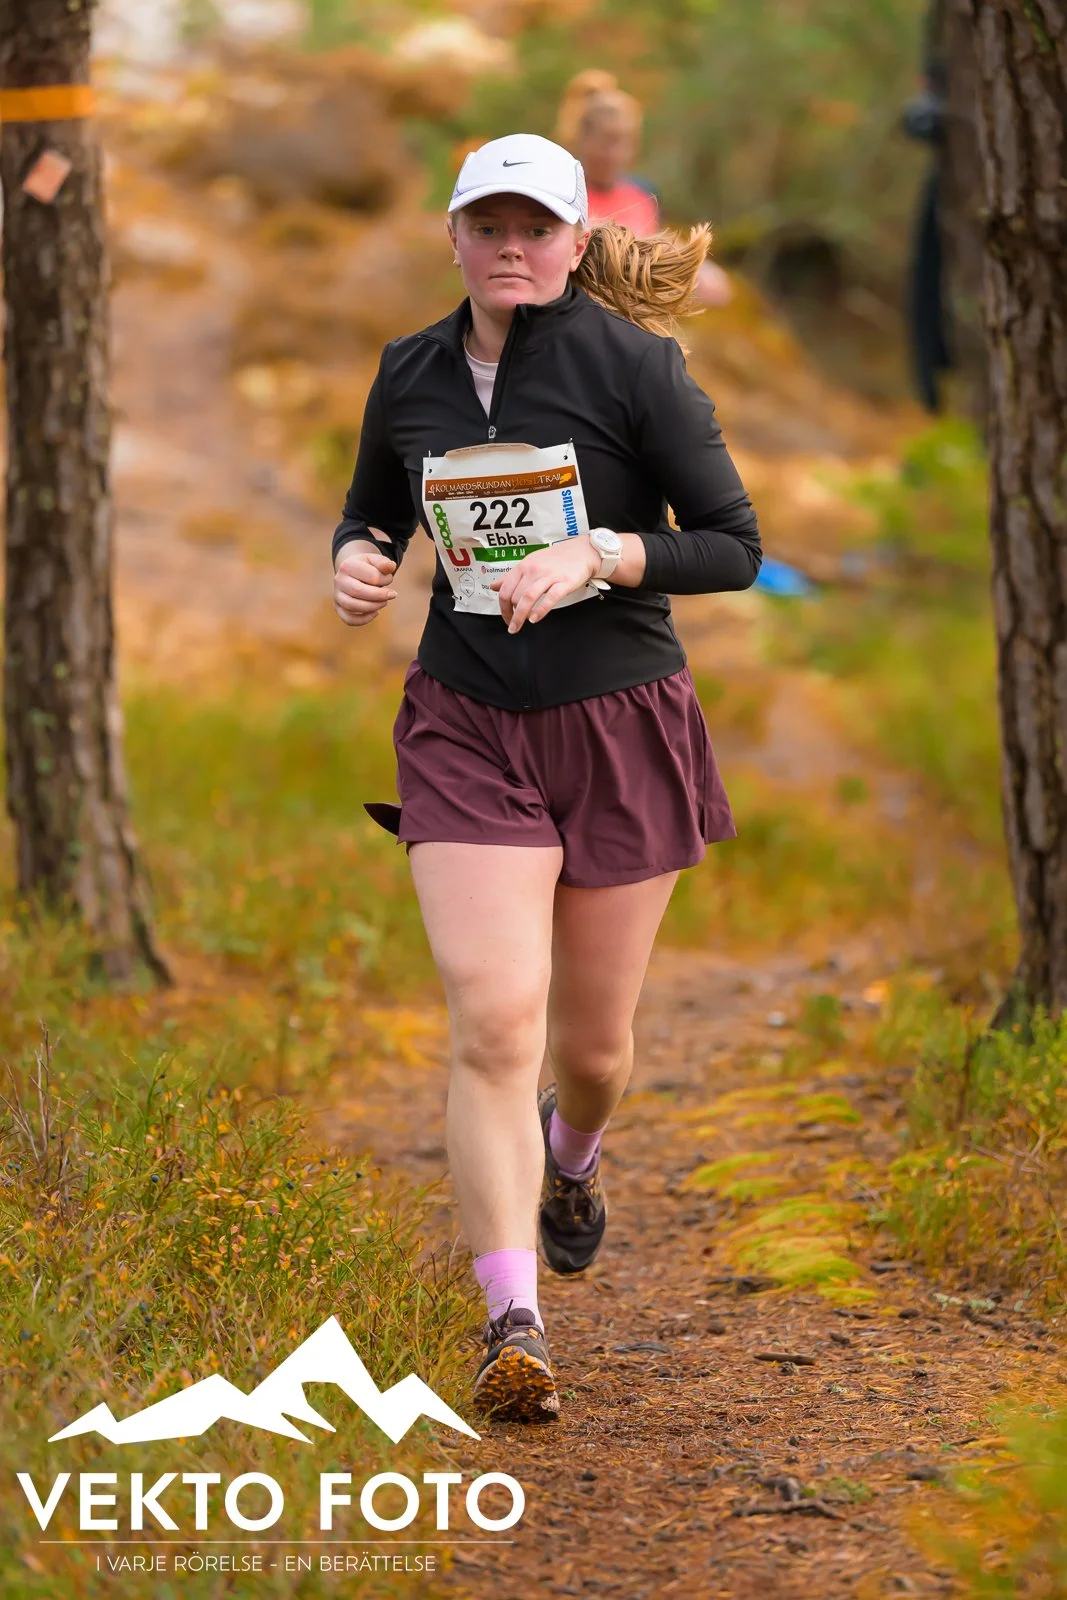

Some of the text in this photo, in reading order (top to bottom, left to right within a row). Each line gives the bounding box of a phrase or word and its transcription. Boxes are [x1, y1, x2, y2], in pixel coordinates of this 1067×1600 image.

[469, 497, 534, 531] 222
[561, 489, 578, 536] Aktivitus
[486, 532, 528, 546] Ebba
